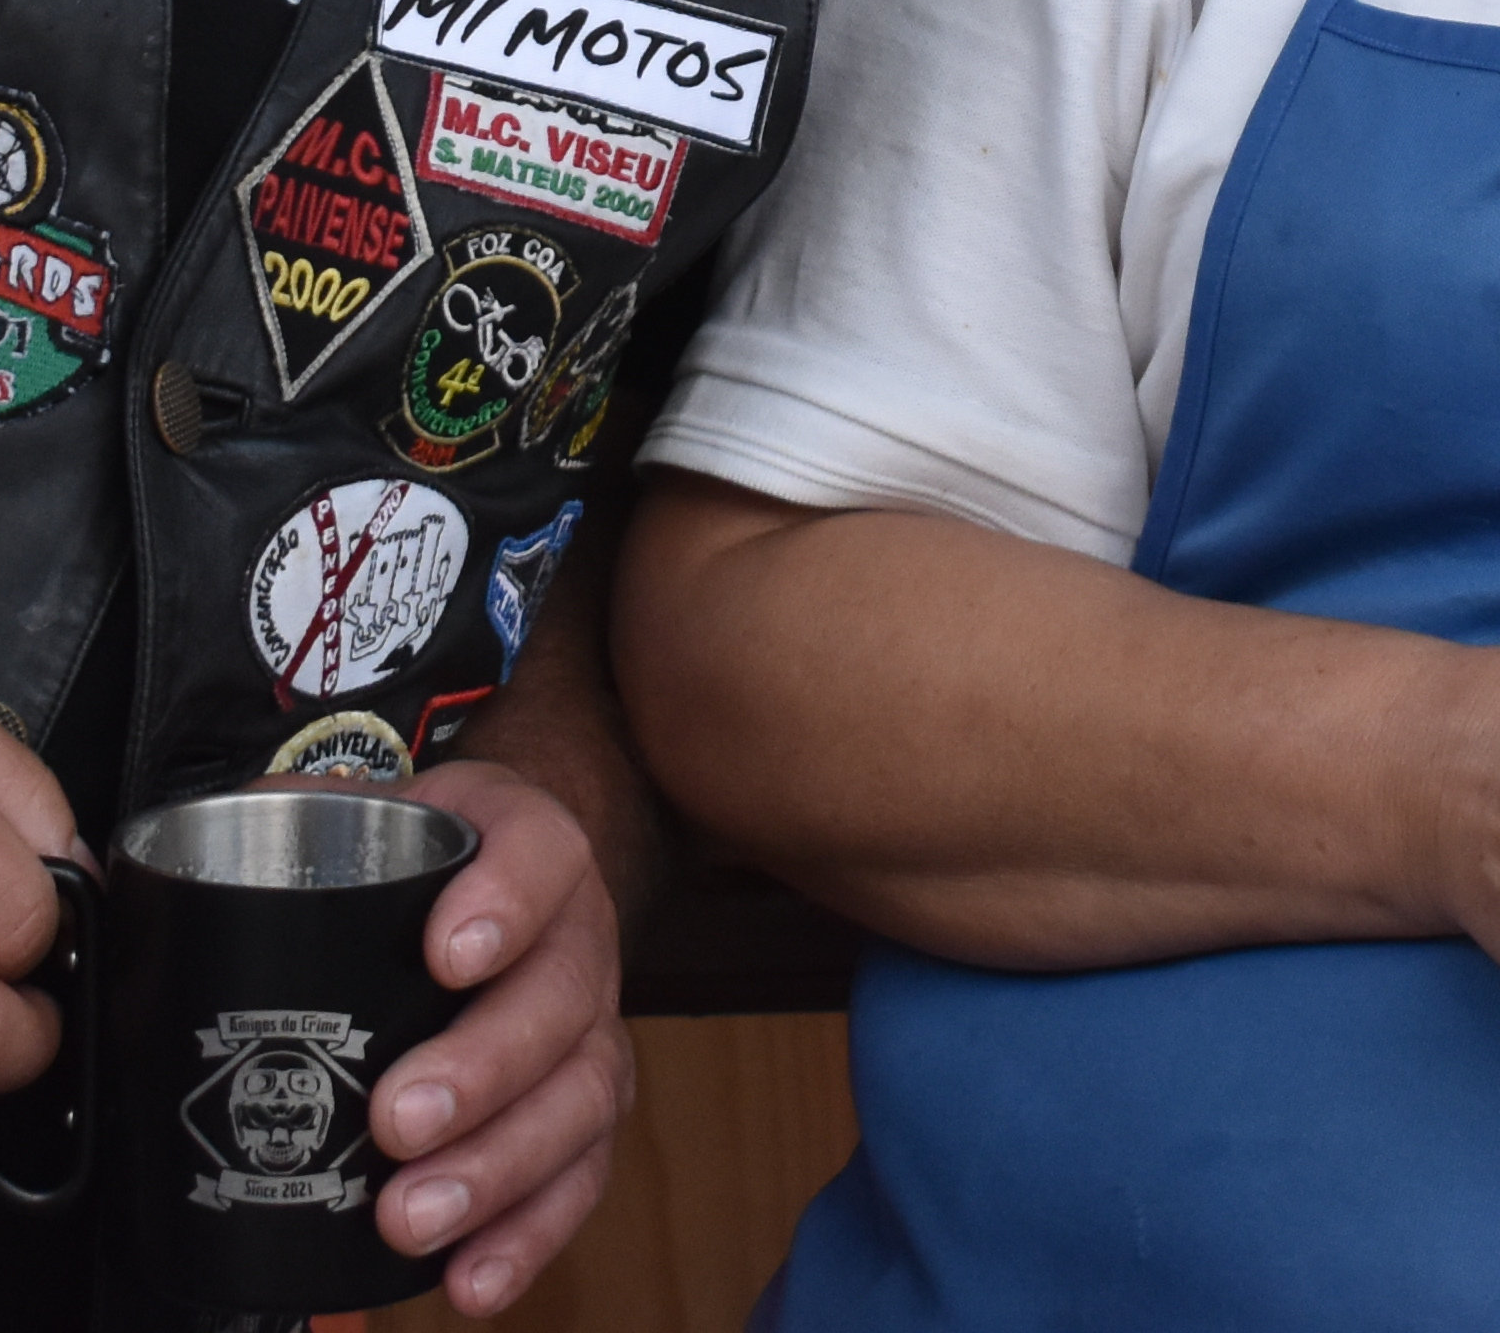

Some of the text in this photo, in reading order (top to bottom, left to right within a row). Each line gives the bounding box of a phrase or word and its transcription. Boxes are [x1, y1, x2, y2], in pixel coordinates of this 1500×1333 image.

[503, 7, 768, 103] MOTOS
[284, 116, 403, 194] M.C.
[434, 136, 655, 222] S. MATEUS 2000
[440, 97, 532, 154] M.C.
[546, 126, 669, 192] VISEU
[252, 173, 412, 271] PAIVENSE
[466, 232, 513, 261] FOZ
[263, 249, 372, 323] 2000
[315, 498, 341, 690] PENEDONO
[229, 1014, 341, 1037] Amigos do Crime
[243, 1180, 313, 1199] Since 2021
